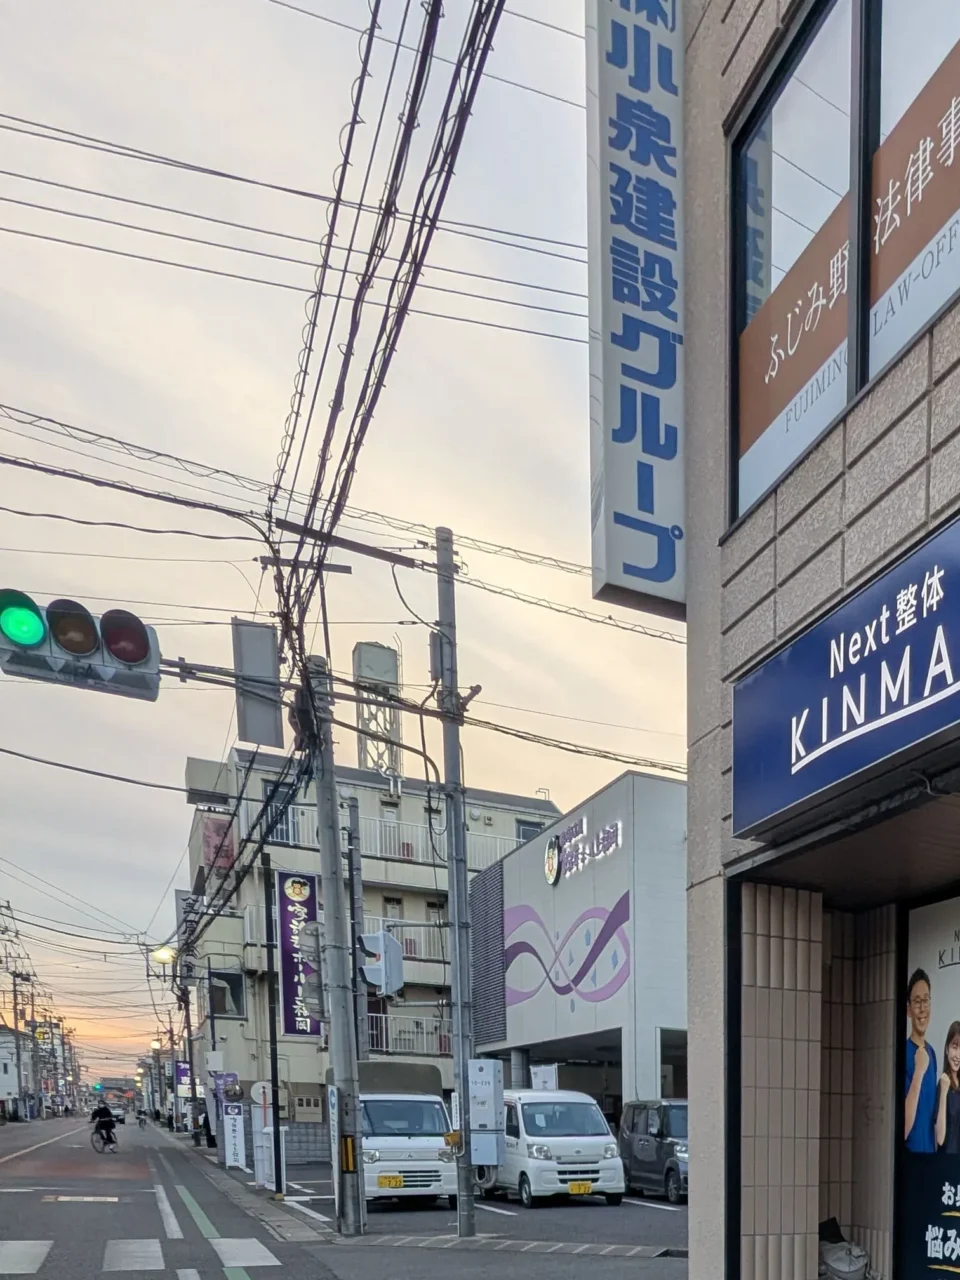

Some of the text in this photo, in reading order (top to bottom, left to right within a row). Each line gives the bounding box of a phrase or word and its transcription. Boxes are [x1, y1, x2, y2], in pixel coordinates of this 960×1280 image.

[765, 240, 849, 384] ふじみ野
[829, 565, 945, 678] Next整体
